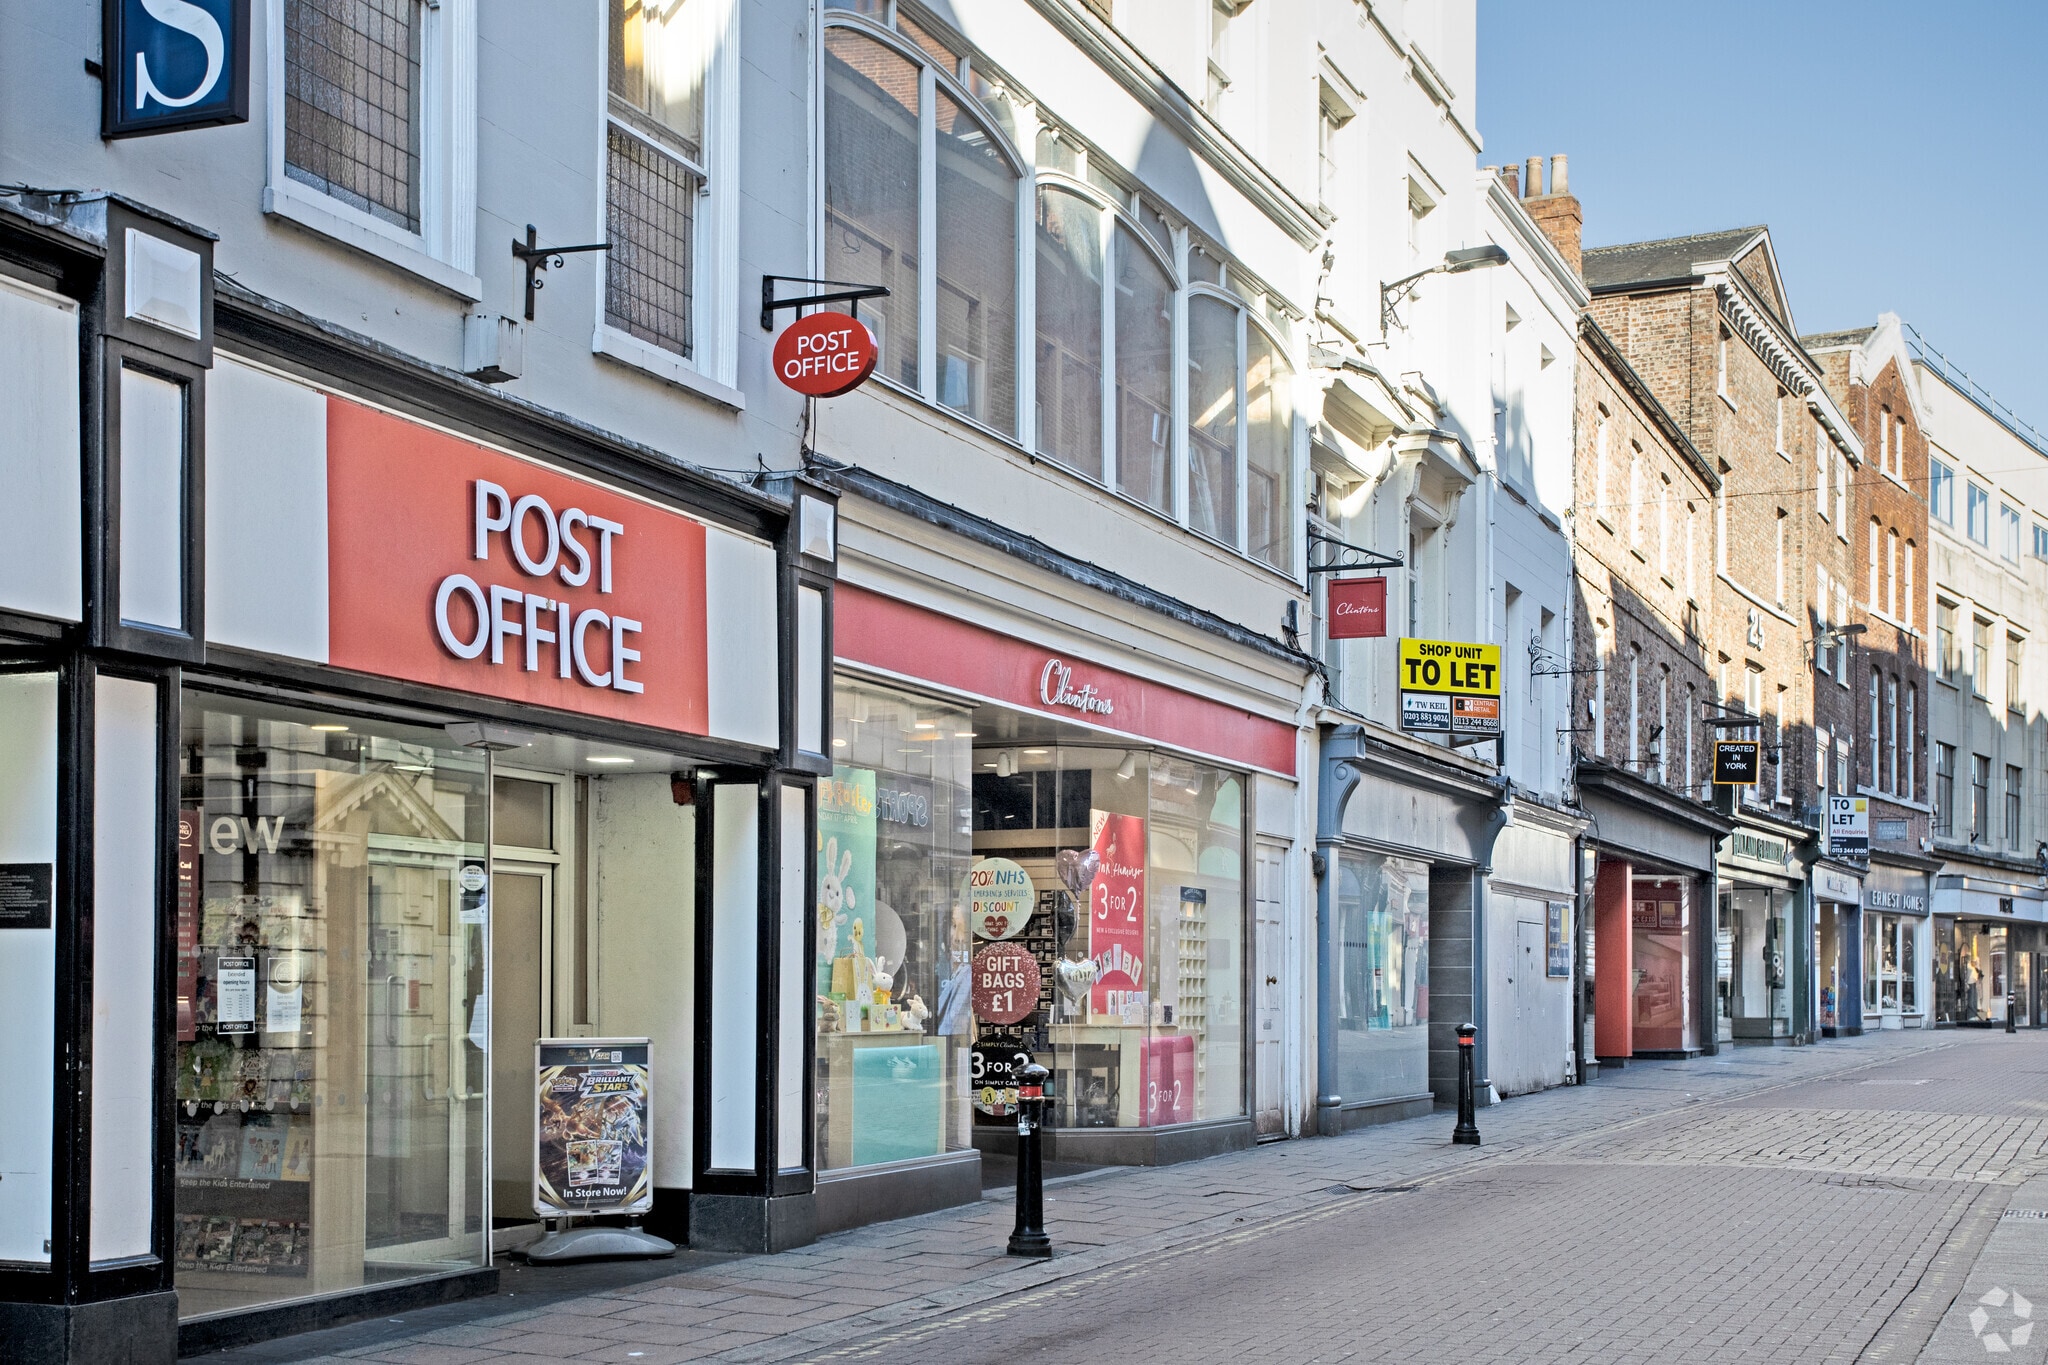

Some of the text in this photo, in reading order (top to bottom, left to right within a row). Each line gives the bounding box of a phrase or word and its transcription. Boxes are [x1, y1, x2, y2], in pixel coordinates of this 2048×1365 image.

[136, 0, 224, 109] S
[797, 329, 853, 355] POST
[783, 350, 860, 379] OFFICE
[475, 478, 624, 593] POST
[1336, 602, 1380, 616] Clintons
[435, 573, 644, 694] OFFICE
[1419, 643, 1483, 660] SHOP UNIT
[1405, 658, 1496, 690] TO LET
[1040, 658, 1114, 715] Clintons
[1415, 701, 1448, 710] TW KEIL
[1404, 712, 1419, 721] 0203
[1420, 712, 1432, 722] 883
[1433, 714, 1449, 724] 9024
[1454, 717, 1470, 725] 0113
[1718, 744, 1756, 753] CREATED
[1732, 753, 1741, 761] IN
[1725, 762, 1748, 770] YORK
[1832, 799, 1850, 810] TO
[1093, 812, 1106, 840] NEW
[1832, 814, 1855, 825] LET
[1841, 828, 1867, 837] Enquiries
[971, 869, 1025, 887] 20% NHS
[1004, 889, 1028, 897] SERVICES
[973, 901, 1020, 913] DISCOUNT
[1098, 882, 1137, 922] 3 FOR 2
[1872, 890, 1924, 912] ERNEST JONES
[986, 956, 1022, 972] GIFT
[982, 972, 1025, 989] BAGS
[991, 989, 1013, 1013] £1
[971, 1051, 986, 1079] 3
[986, 1062, 1012, 1073] FOR
[586, 1075, 633, 1086] BRILLIANT
[592, 1082, 629, 1093] STARS
[1149, 1080, 1181, 1113] 3 FOR 2
[180, 1179, 198, 1187] Keep
[230, 1181, 271, 1190] Entertained
[563, 1186, 627, 1198] In Store Now!
[177, 1261, 268, 1274] Keep the Kids Entertained
